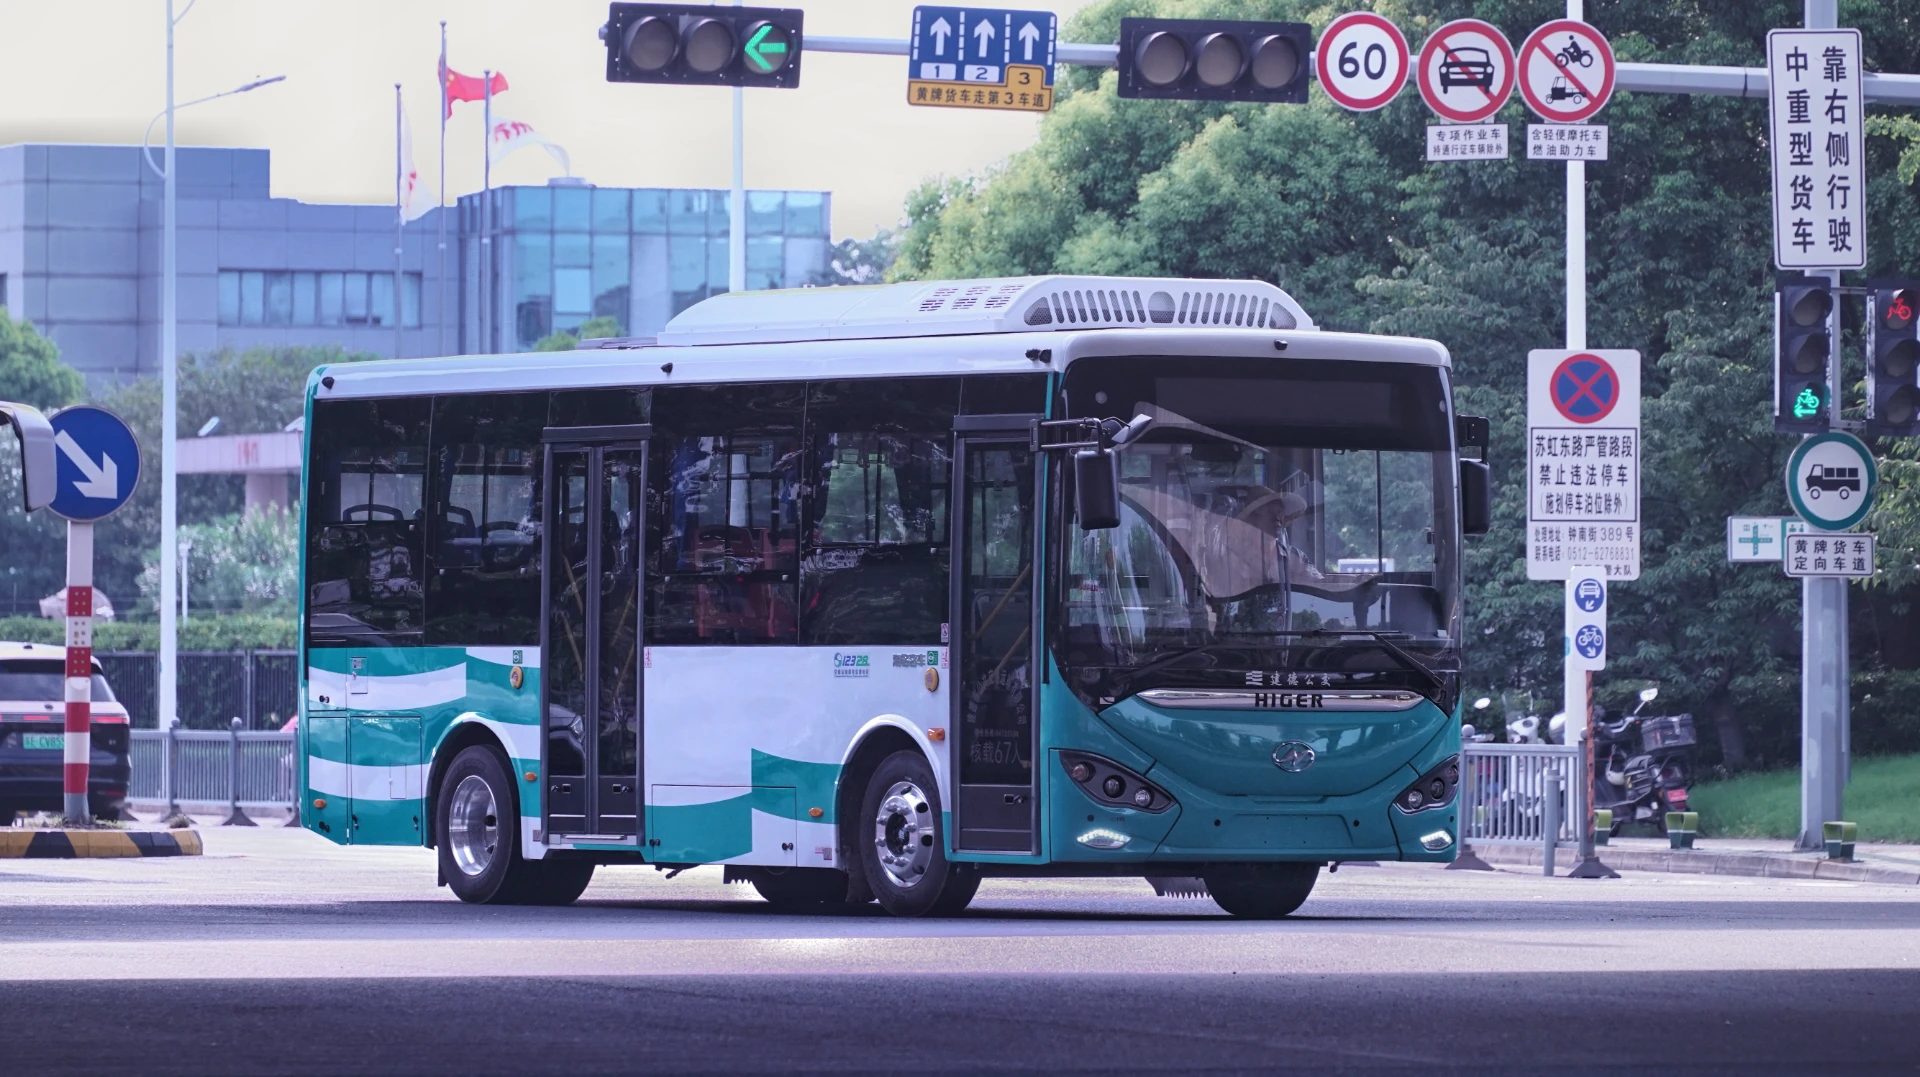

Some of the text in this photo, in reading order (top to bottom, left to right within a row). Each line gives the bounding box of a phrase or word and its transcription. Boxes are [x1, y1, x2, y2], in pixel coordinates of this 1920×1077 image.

[1339, 42, 1386, 80] 60
[934, 65, 940, 78] 1
[976, 67, 988, 80] 2
[1018, 72, 1030, 85] 3
[917, 87, 1045, 108] 黄牌货车走第3车道
[1436, 129, 1501, 142] 专项作业车
[1531, 129, 1602, 142] 含轻便摩托车
[1532, 144, 1596, 157] 燃油助力车
[1786, 46, 1815, 253] 中重型货车
[1822, 46, 1852, 252] 靠右侧行驶
[1535, 435, 1632, 458] 苏虹东路严管路段
[1539, 463, 1628, 487] 禁止违法停车
[1794, 539, 1866, 555] 黄牌货车
[1794, 557, 1866, 571] 定向车道
[1270, 671, 1331, 687] 建德公交
[1255, 693, 1324, 708] HIGER
[970, 741, 1023, 765] 核载67人
